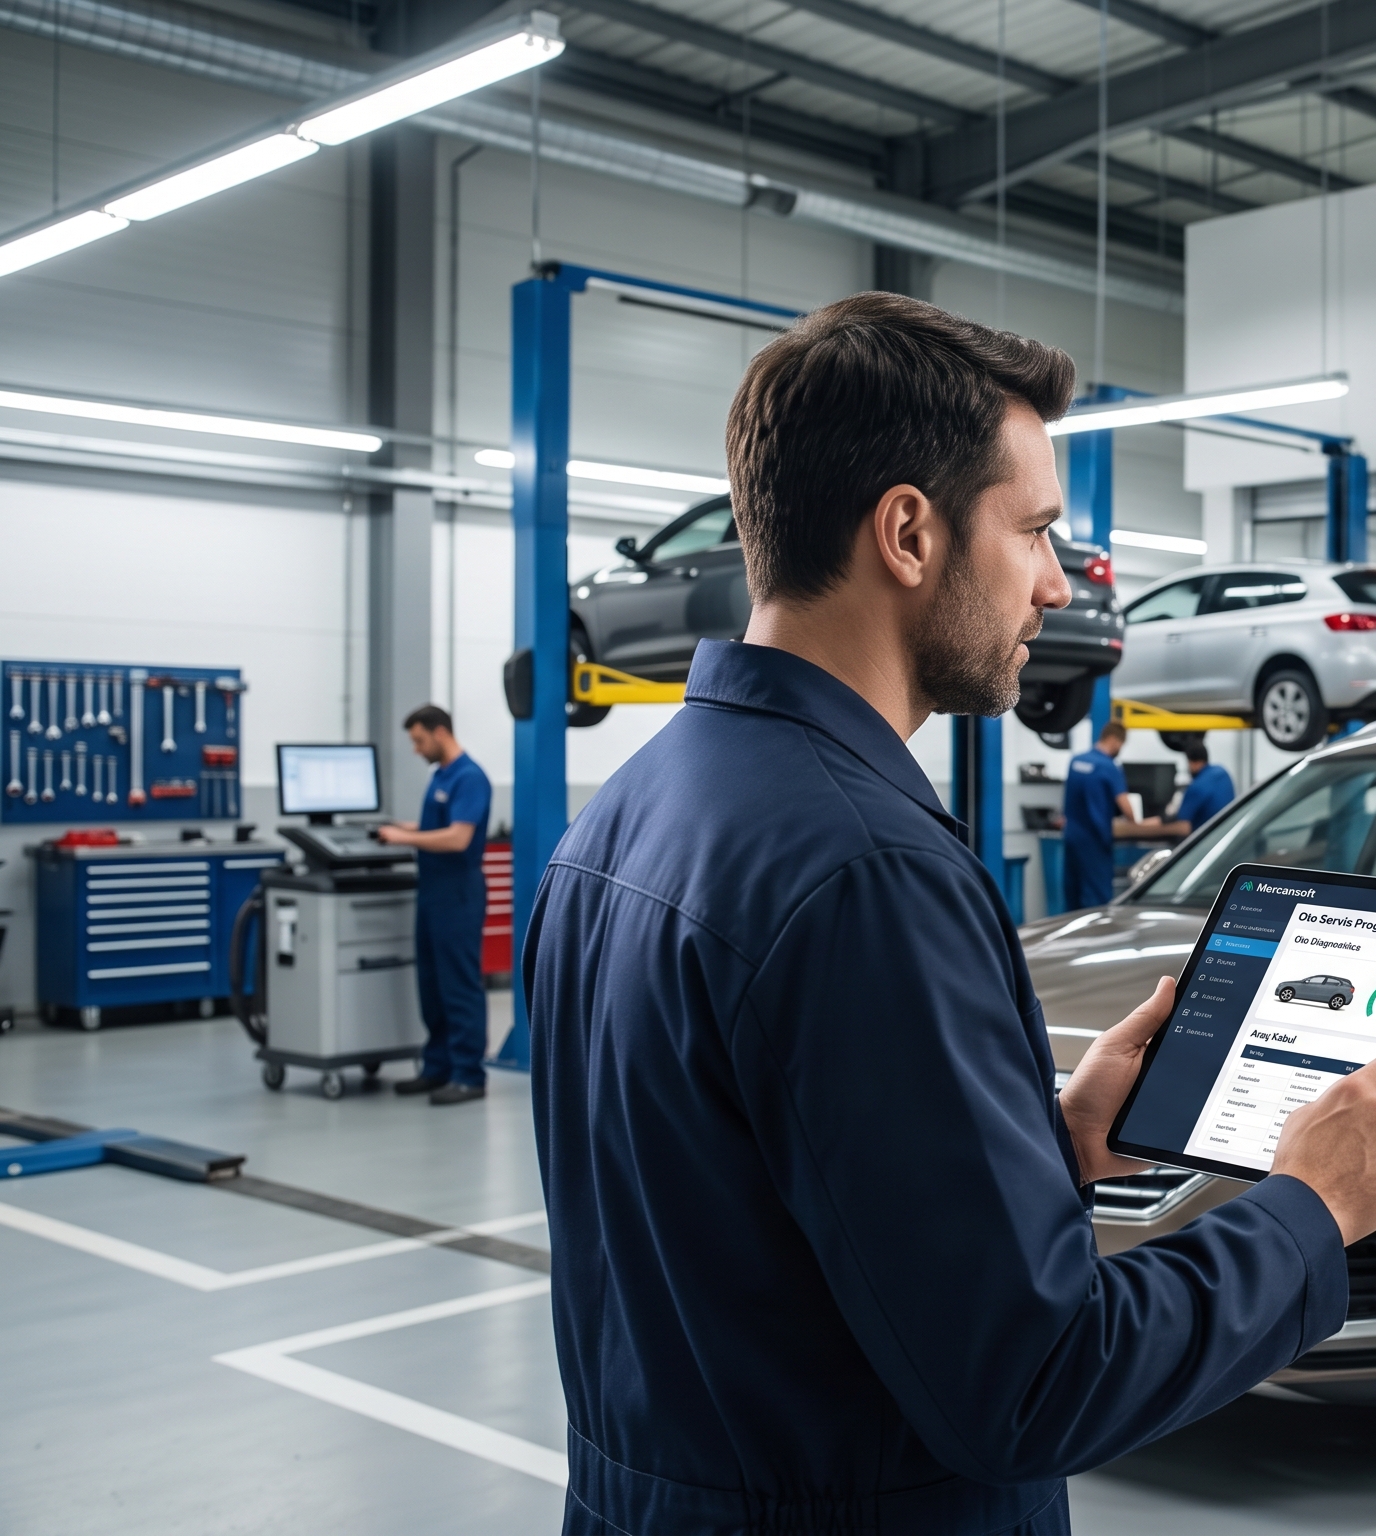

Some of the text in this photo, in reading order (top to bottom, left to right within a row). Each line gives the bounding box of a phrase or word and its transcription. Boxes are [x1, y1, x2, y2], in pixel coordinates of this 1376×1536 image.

[1256, 882, 1316, 899] Mercansoft
[1298, 912, 1318, 923] Oto
[1319, 914, 1353, 927] Servis
[1271, 1033, 1297, 1044] Kabul
